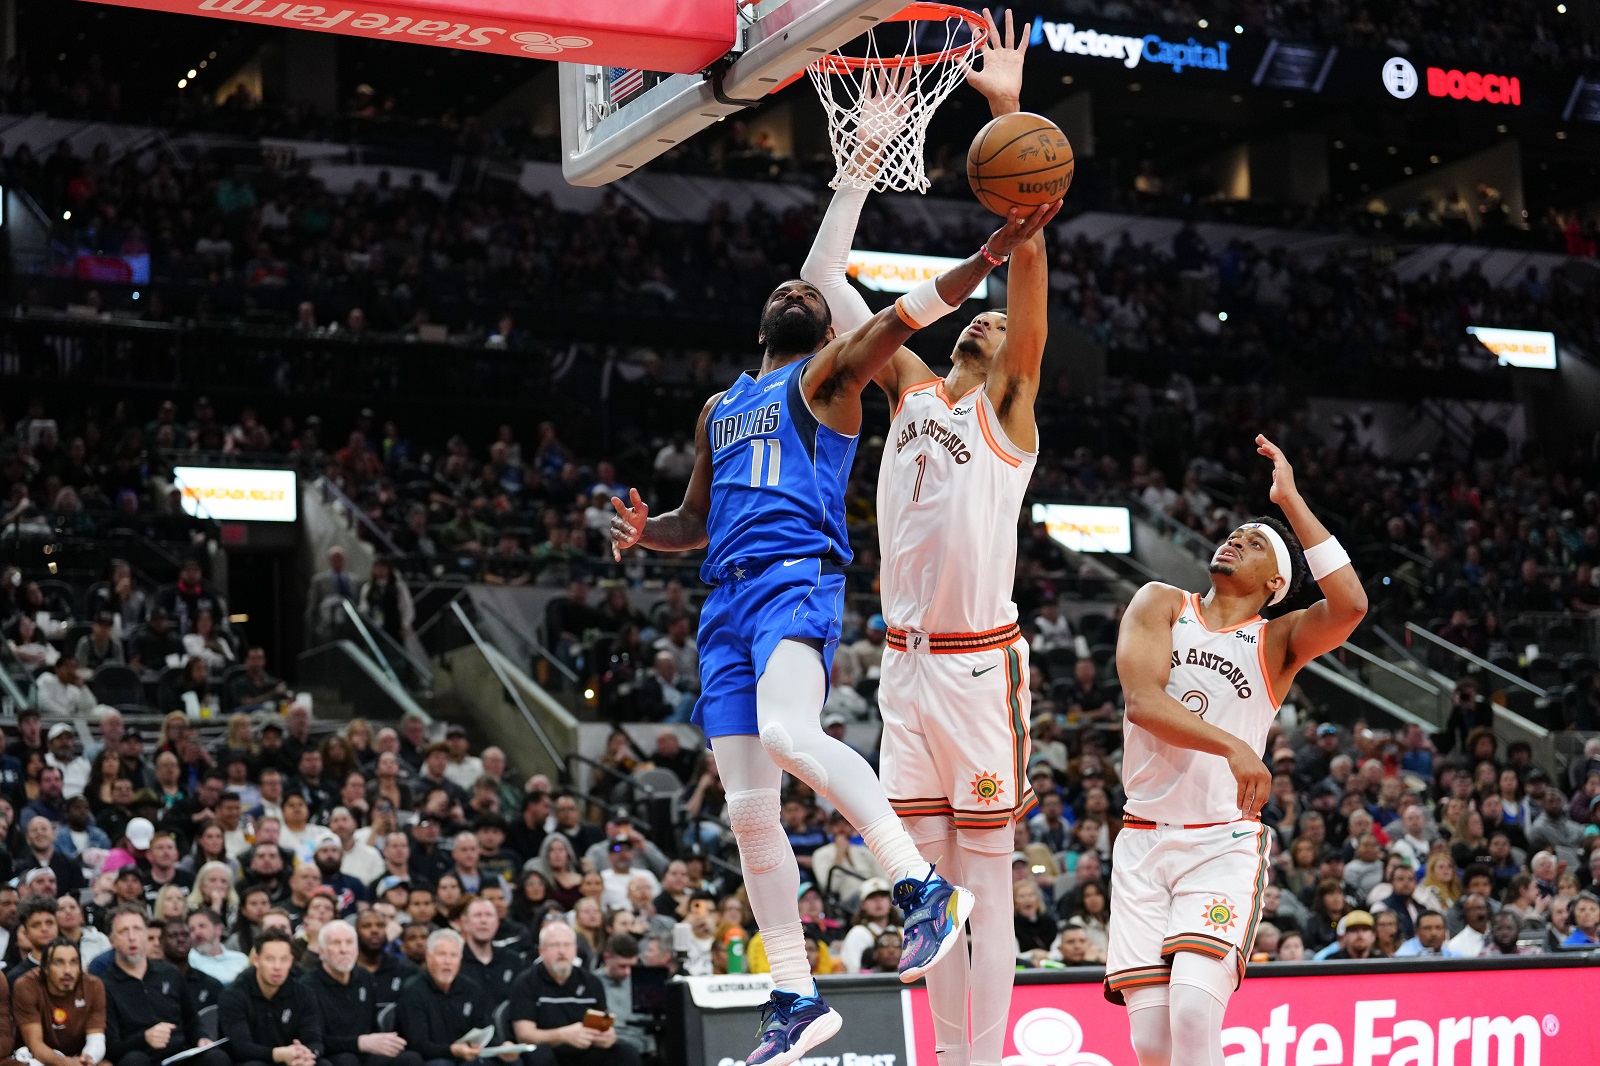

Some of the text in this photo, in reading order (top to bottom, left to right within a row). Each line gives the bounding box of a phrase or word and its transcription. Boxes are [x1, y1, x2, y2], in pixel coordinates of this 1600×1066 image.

[1426, 66, 1521, 106] BOSCH
[712, 401, 782, 453] DALLAS
[896, 420, 918, 455] SAN
[750, 438, 782, 488] 11
[911, 453, 927, 503] 1
[1185, 647, 1252, 699] ANTONIO
[1221, 998, 1542, 1066] ateFarm
